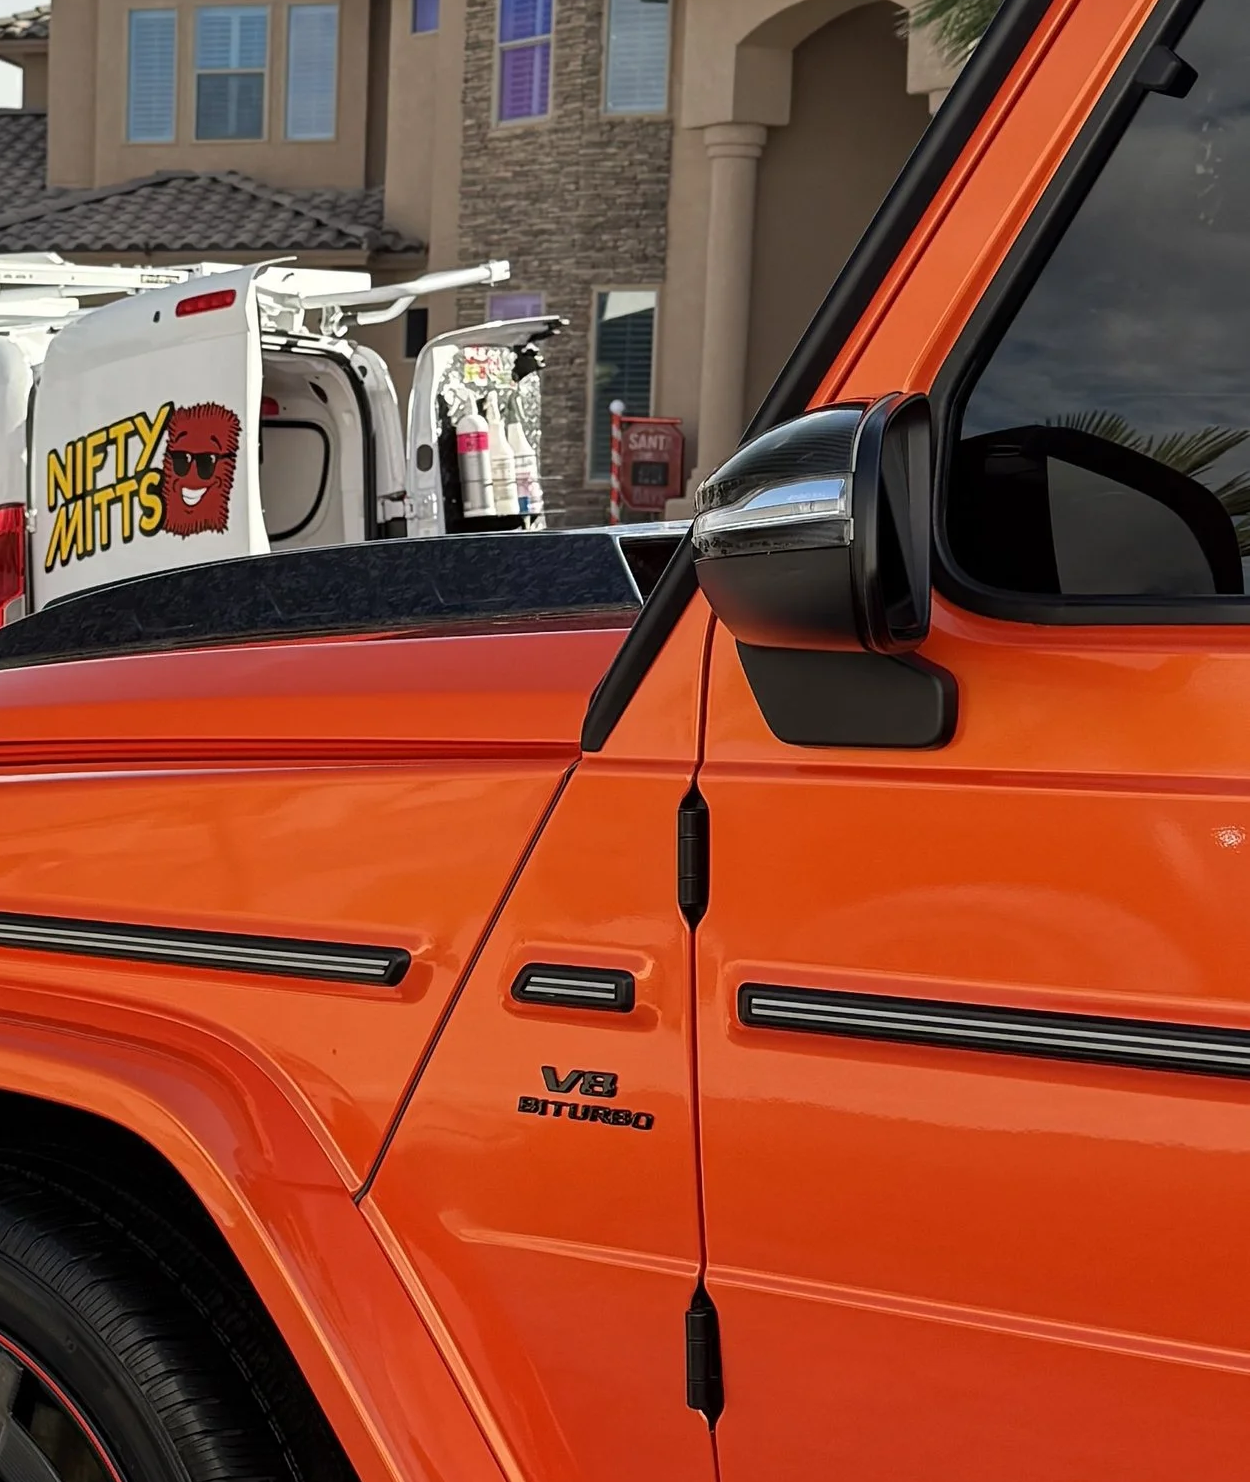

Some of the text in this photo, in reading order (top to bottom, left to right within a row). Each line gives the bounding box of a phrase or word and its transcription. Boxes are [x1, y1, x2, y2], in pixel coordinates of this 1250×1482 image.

[48, 401, 174, 512] NIFTY
[45, 468, 166, 573] MITTS
[517, 1096, 655, 1131] BITURBO
[541, 1065, 618, 1098] V8
